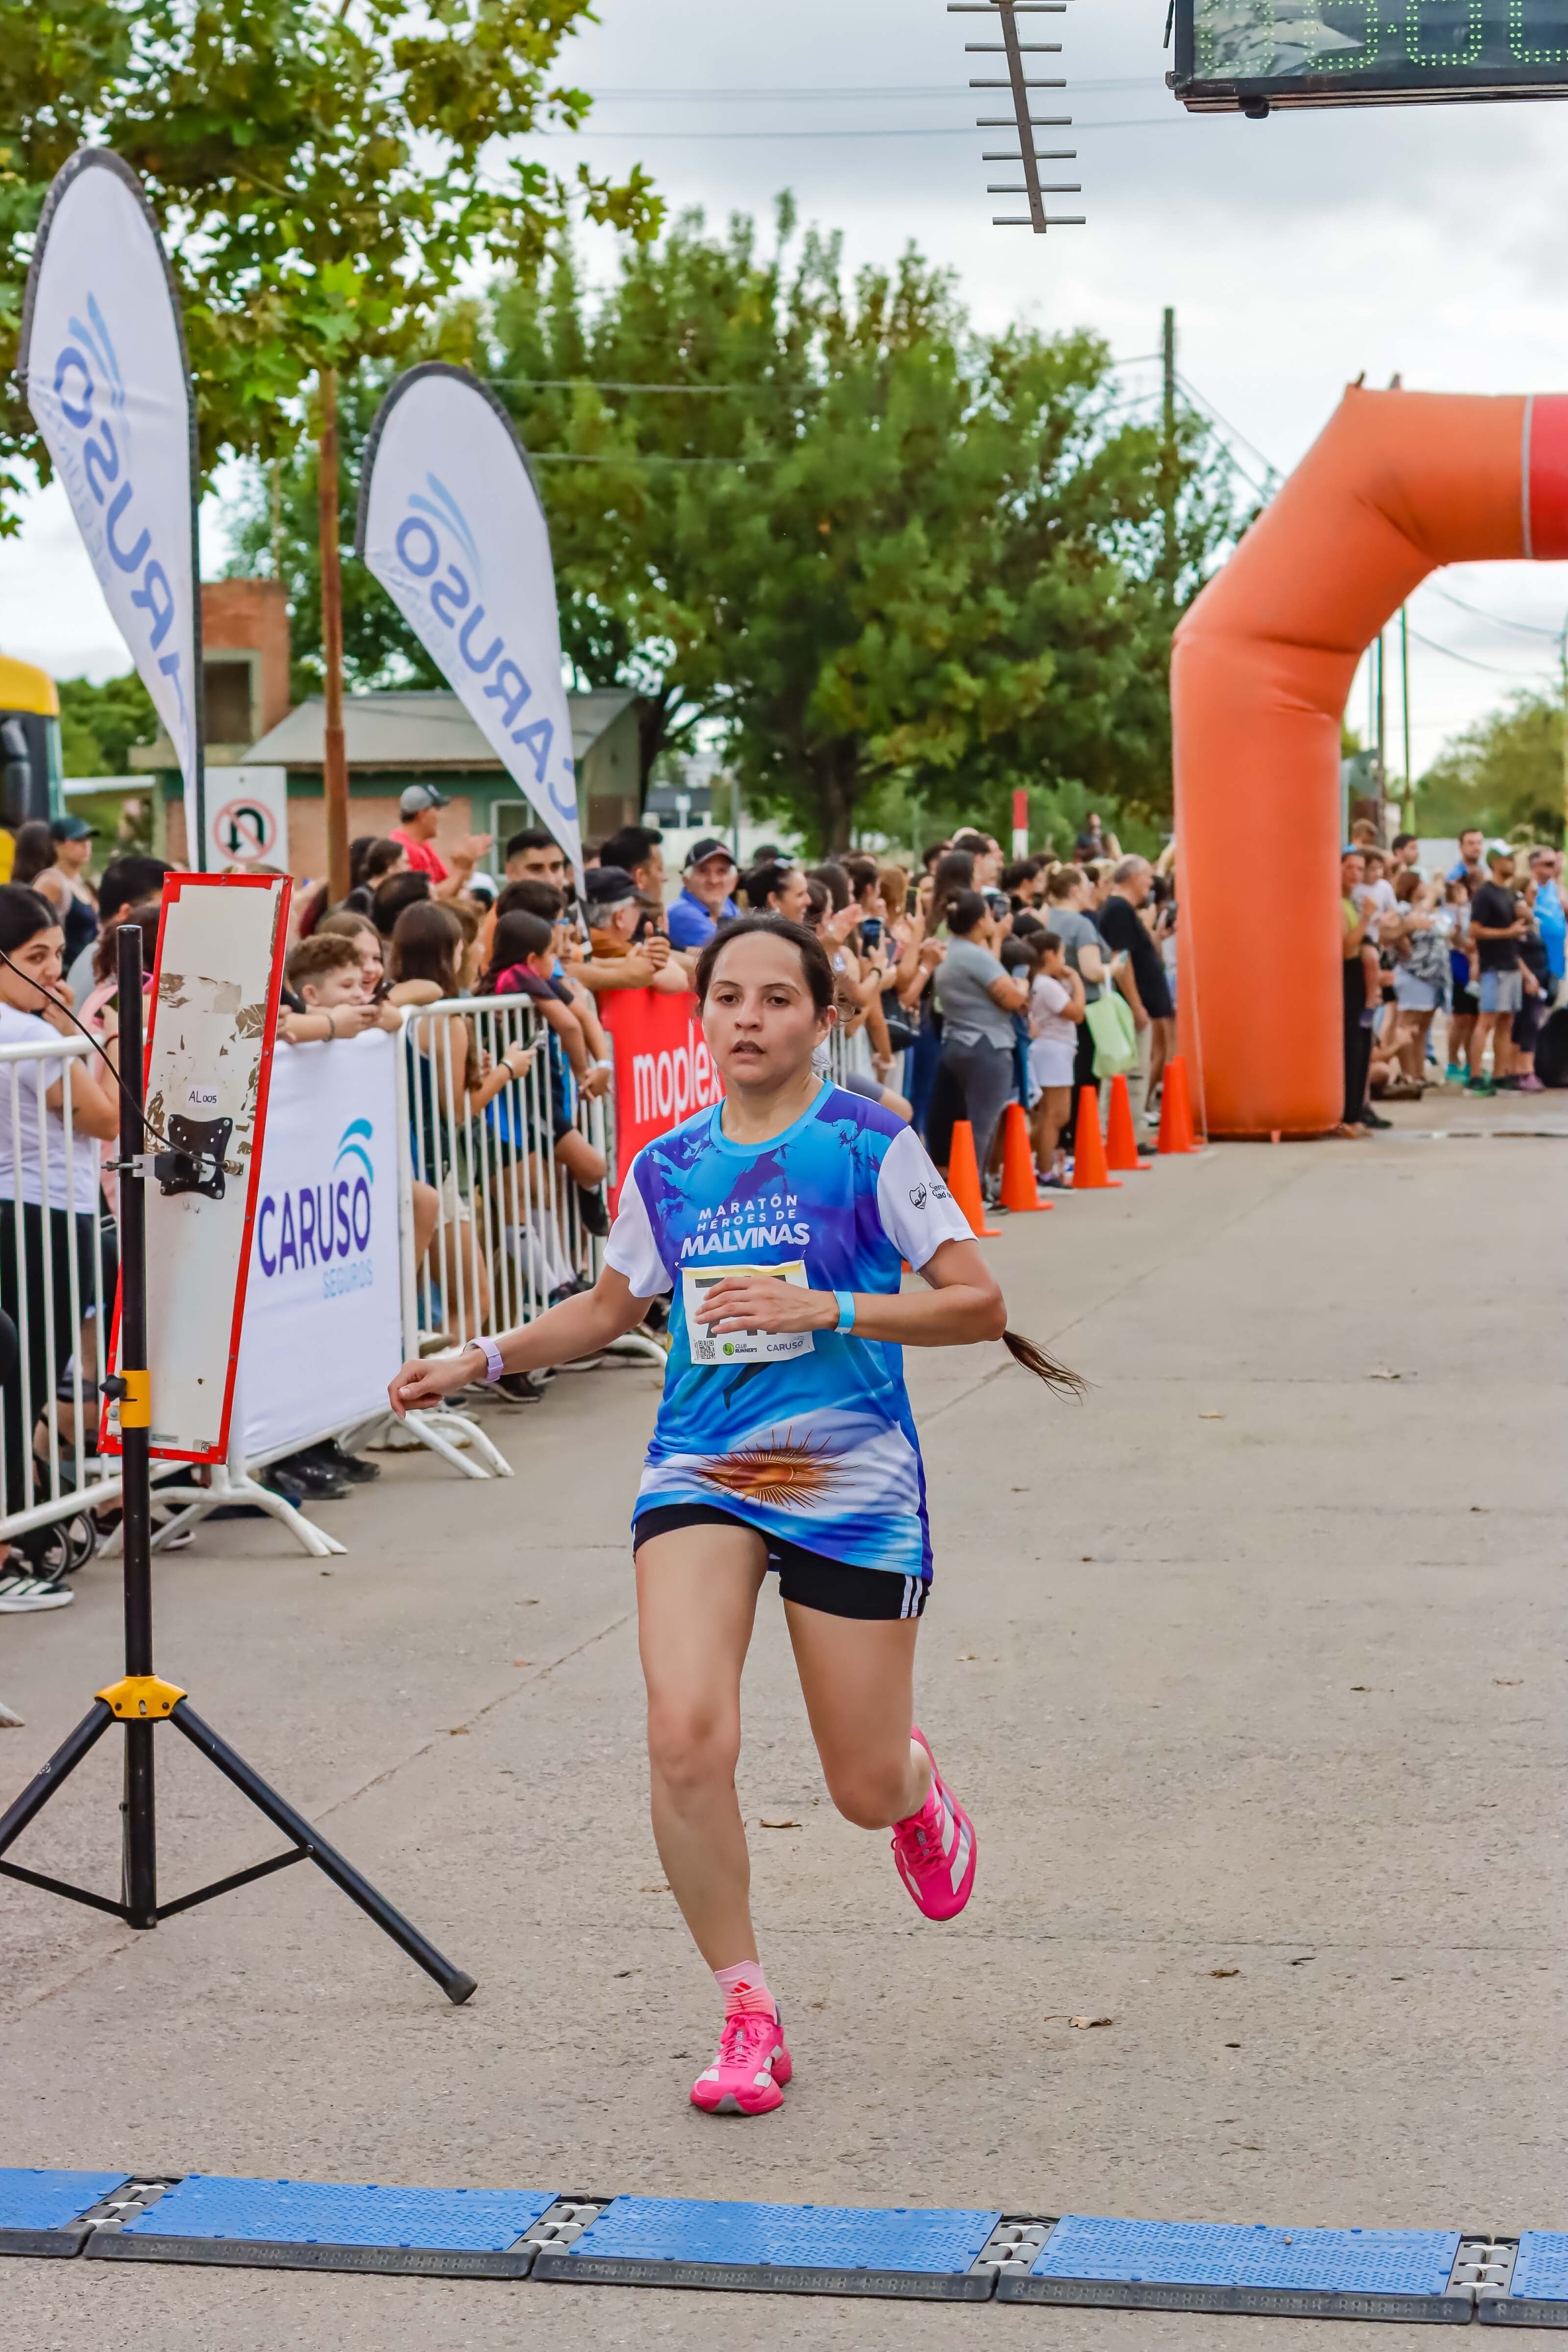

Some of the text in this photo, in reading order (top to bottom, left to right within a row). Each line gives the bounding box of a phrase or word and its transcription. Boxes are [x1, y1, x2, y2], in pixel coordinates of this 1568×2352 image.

[697, 1209, 796, 1231] HÉROES DE
[699, 1193, 798, 1220] MARATÓN
[258, 1176, 370, 1277] CARUSO
[680, 1223, 810, 1259] MALVINAS
[766, 1340, 804, 1352] CARUSO
